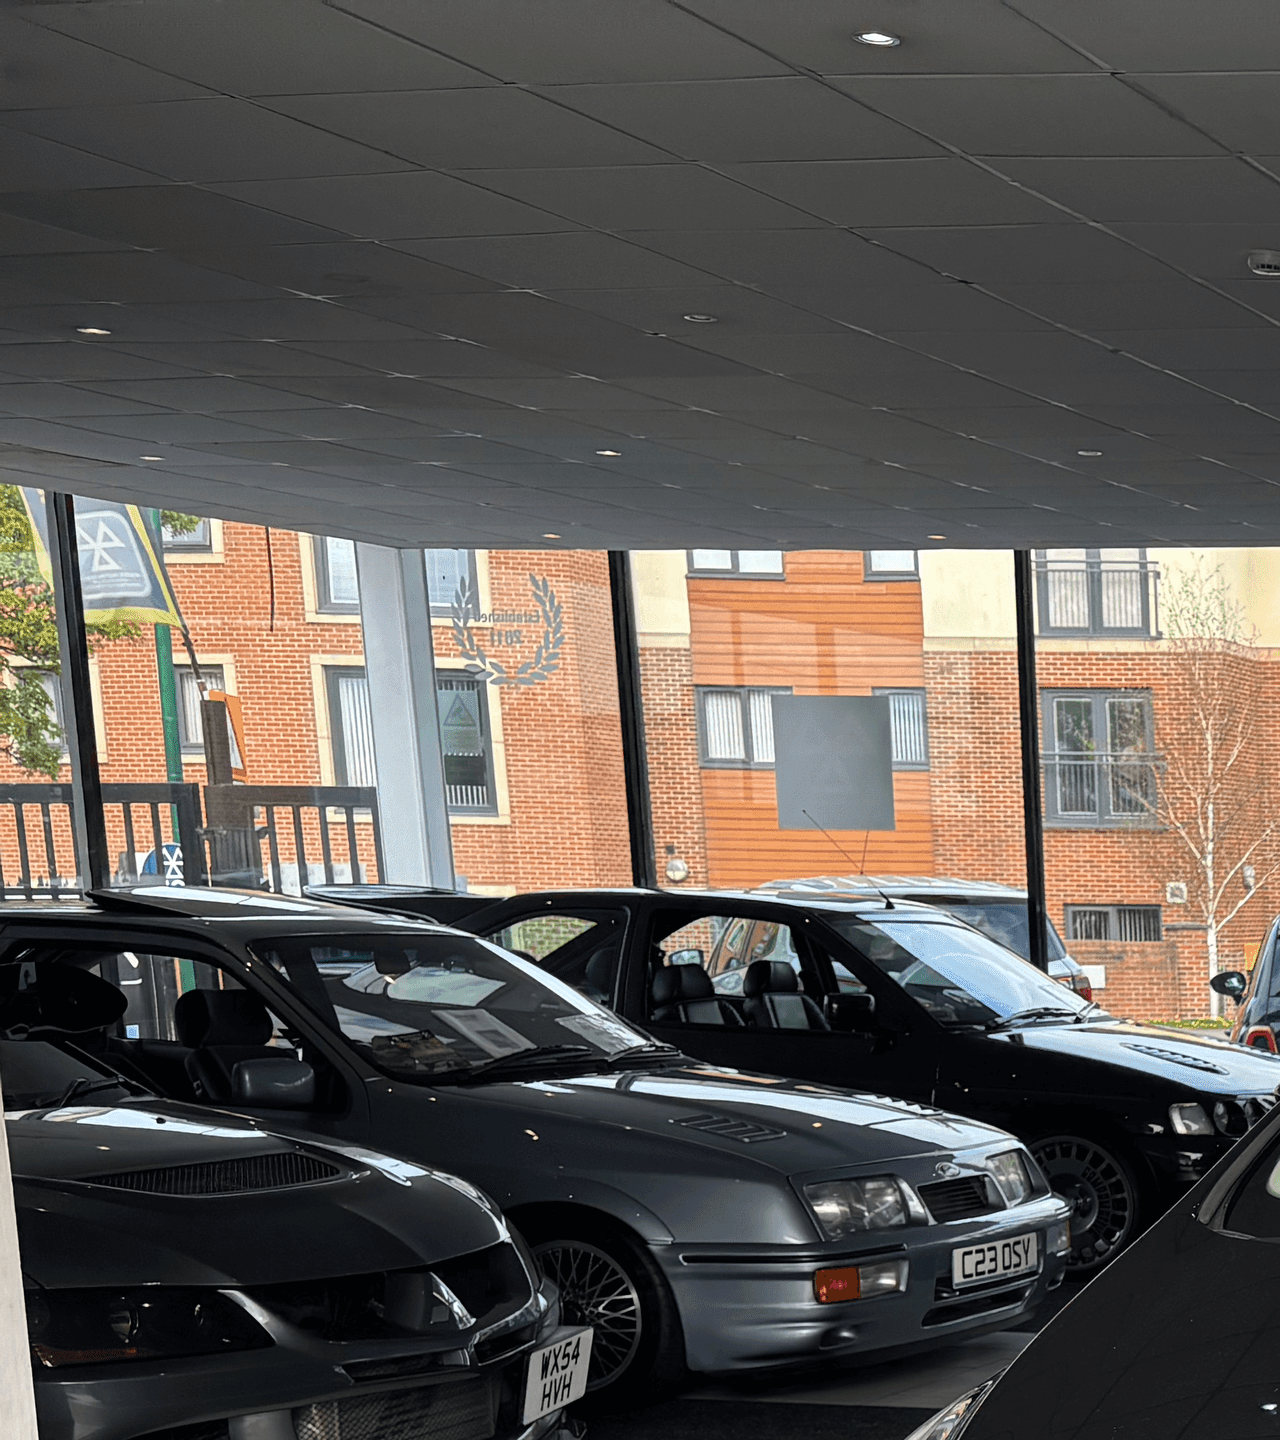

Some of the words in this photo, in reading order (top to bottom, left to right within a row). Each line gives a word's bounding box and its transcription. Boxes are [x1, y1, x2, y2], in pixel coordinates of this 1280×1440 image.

[962, 1246, 997, 1279] C23
[541, 1336, 581, 1380] WX54
[541, 1370, 573, 1411] HVH
